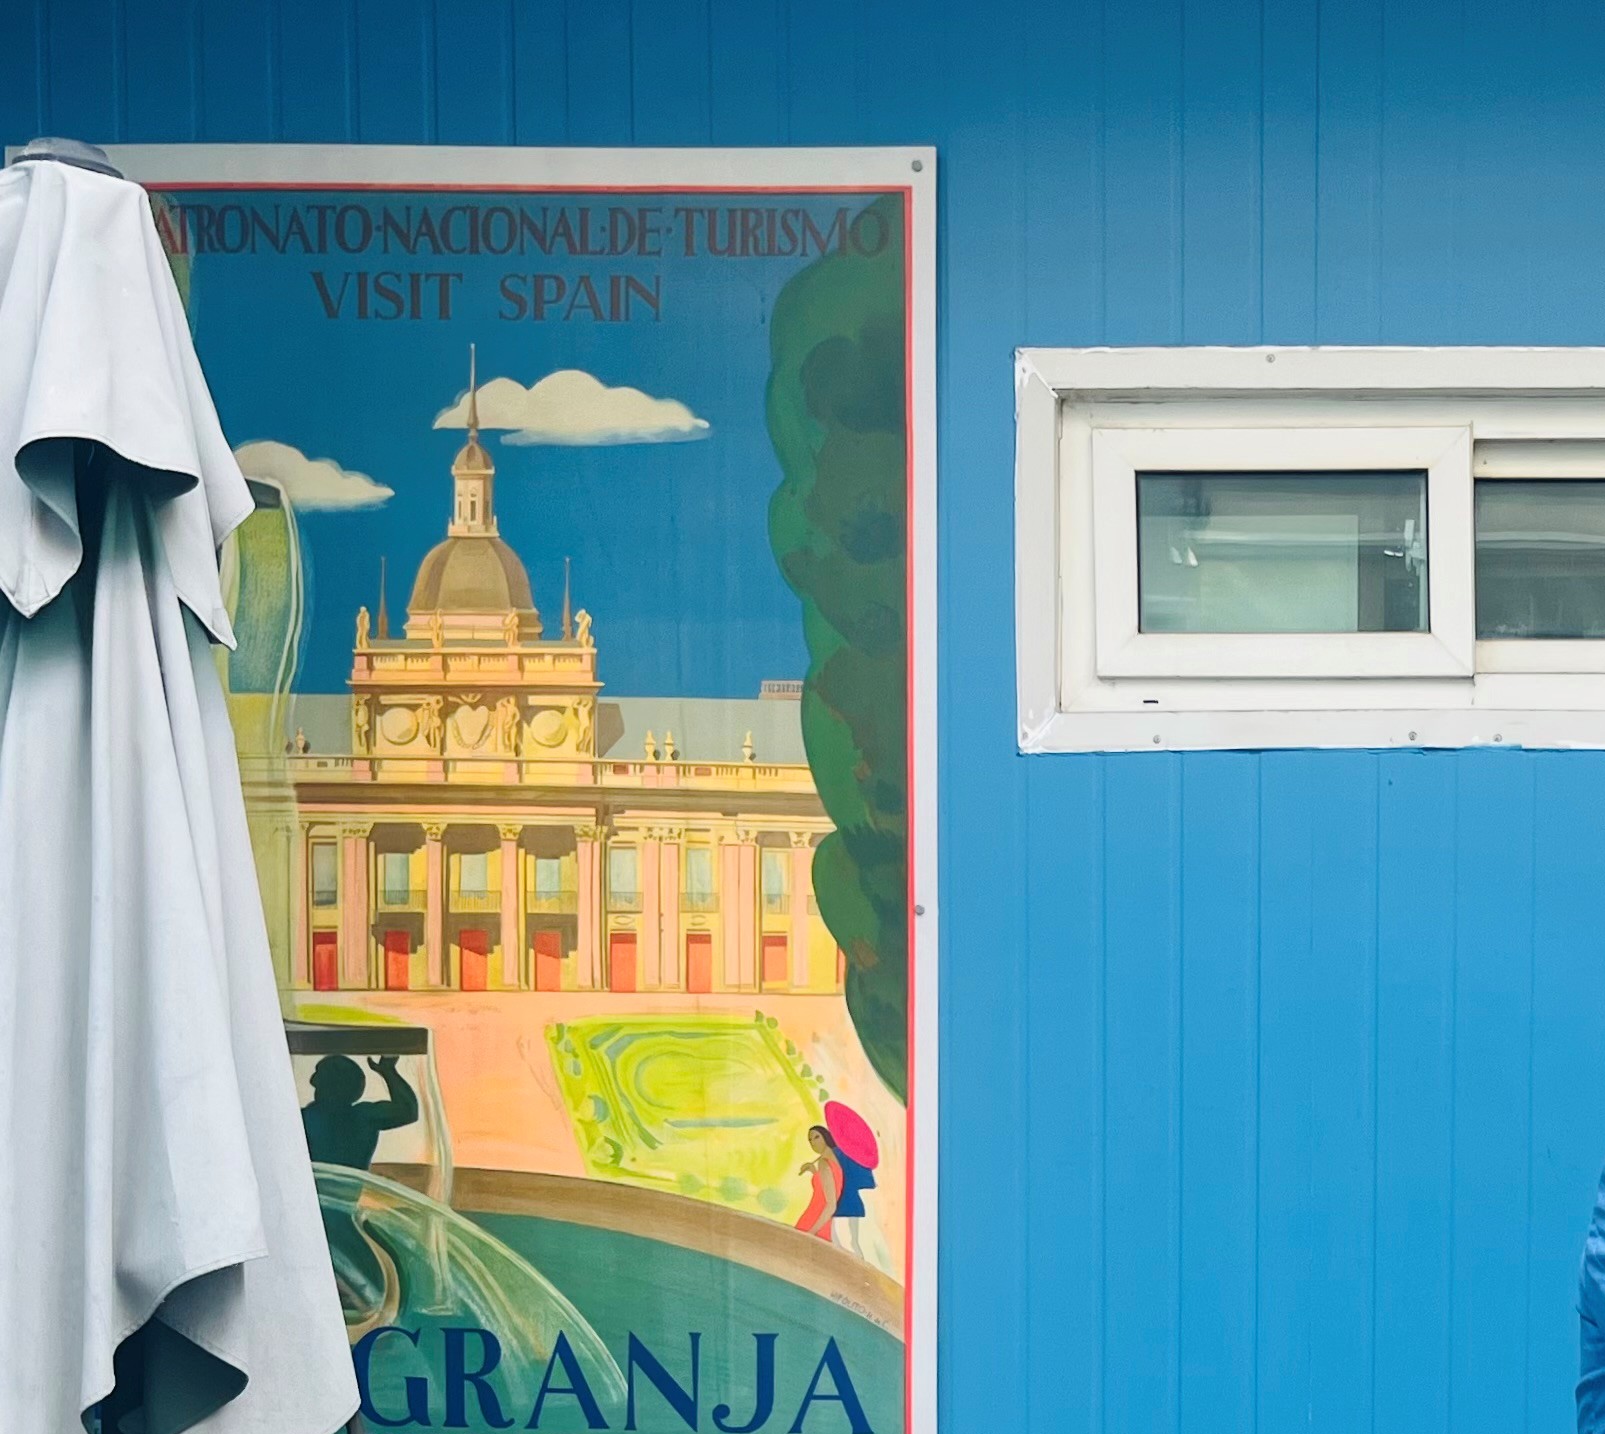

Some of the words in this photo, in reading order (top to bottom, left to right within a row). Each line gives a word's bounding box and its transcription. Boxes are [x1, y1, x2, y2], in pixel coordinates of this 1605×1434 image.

[156, 203, 373, 255] ATRONATO
[382, 204, 598, 257] NACIONAL
[674, 207, 890, 259] TURISMO
[310, 271, 464, 321] VISIT
[498, 273, 663, 323] SPAIN
